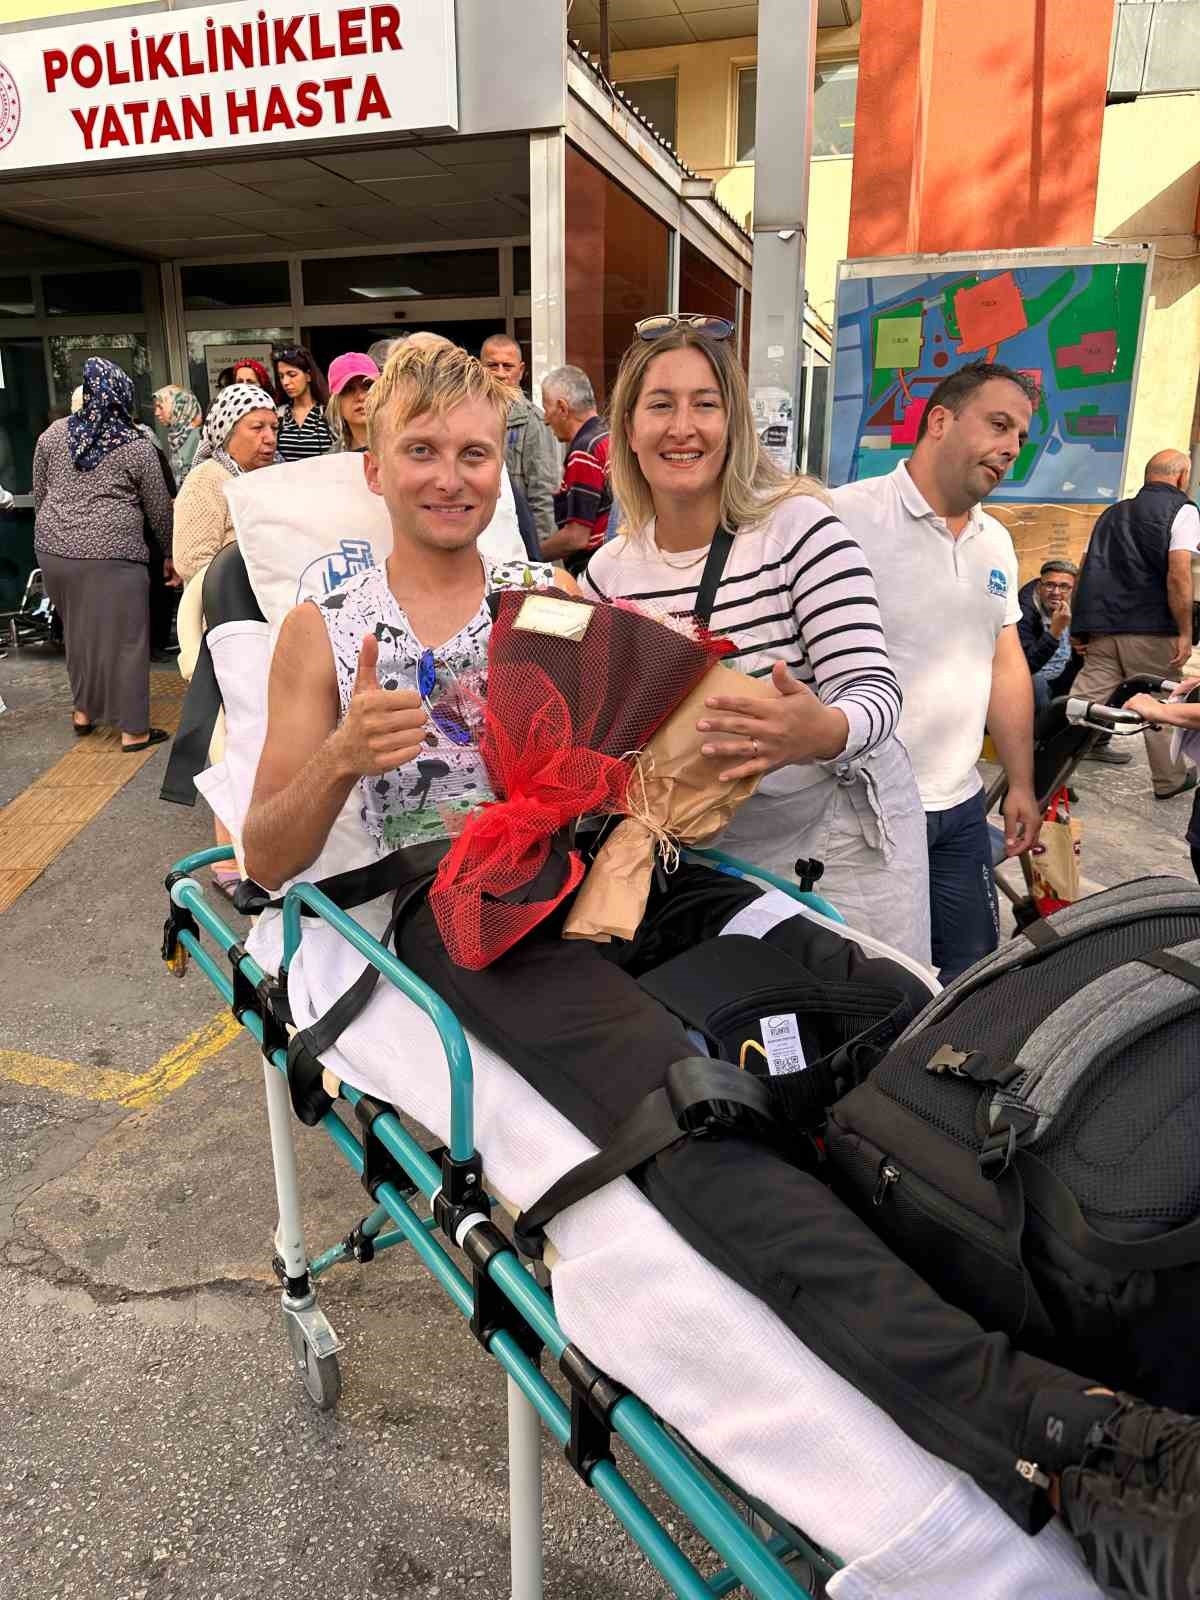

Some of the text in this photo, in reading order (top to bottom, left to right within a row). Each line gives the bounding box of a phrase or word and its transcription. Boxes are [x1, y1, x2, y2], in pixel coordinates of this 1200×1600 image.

[43, 4, 402, 93] POLİKLİNİKLER
[71, 93, 213, 150] YATAN
[226, 73, 392, 135] HASTA
